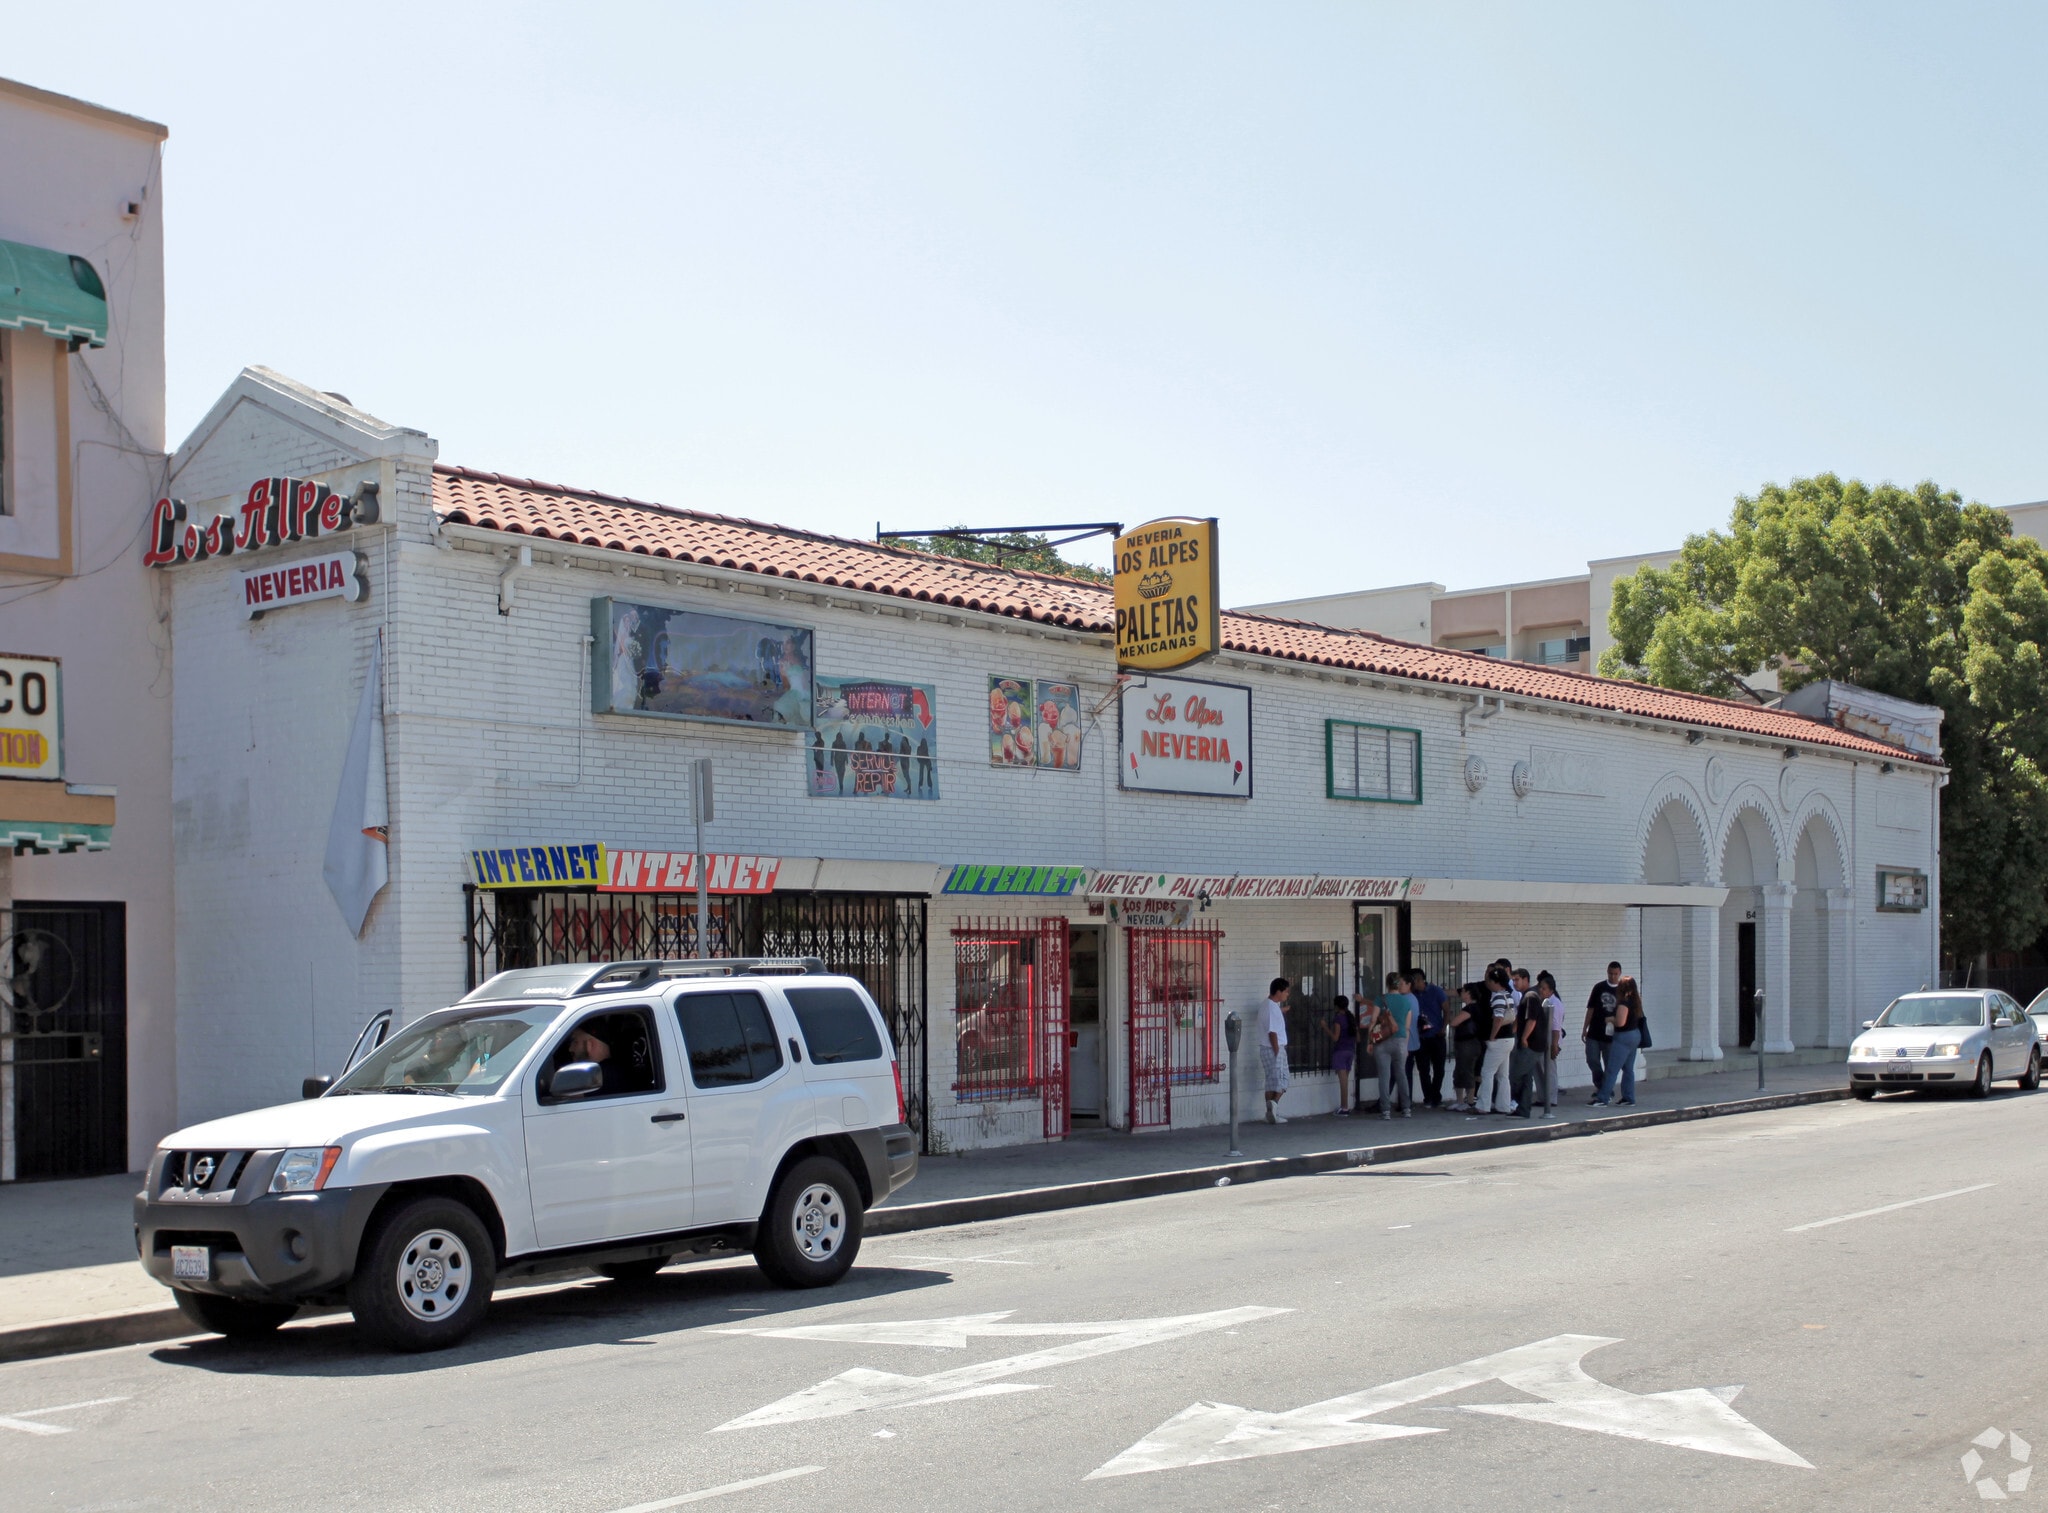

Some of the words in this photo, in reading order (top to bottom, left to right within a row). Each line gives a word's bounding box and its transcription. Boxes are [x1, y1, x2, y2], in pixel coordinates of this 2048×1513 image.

[143, 497, 235, 568] Los
[1126, 527, 1182, 548] NEVERIA
[1113, 550, 1142, 576] LOS
[1148, 539, 1199, 569] ALPES
[244, 560, 345, 605] NEVERIA
[1115, 595, 1198, 645] PALETAS
[1119, 635, 1197, 659] MEXICANAS
[1146, 692, 1176, 725] Los
[1184, 694, 1225, 730] Alpes
[1141, 730, 1231, 764] NEVERIA
[472, 843, 600, 884] INTERNET
[602, 850, 779, 889] INTERNET
[946, 864, 1080, 893] INTERNET
[1090, 873, 1153, 896] NIEVES
[1168, 877, 1234, 898] PALETAS
[1233, 878, 1311, 898] MEXICANAS
[1311, 878, 1350, 897] AGUAS
[1350, 879, 1399, 898] FRESCAS
[1121, 898, 1142, 913] Los
[1143, 898, 1177, 914] Alpes
[1126, 914, 1164, 925] NEVERIA
